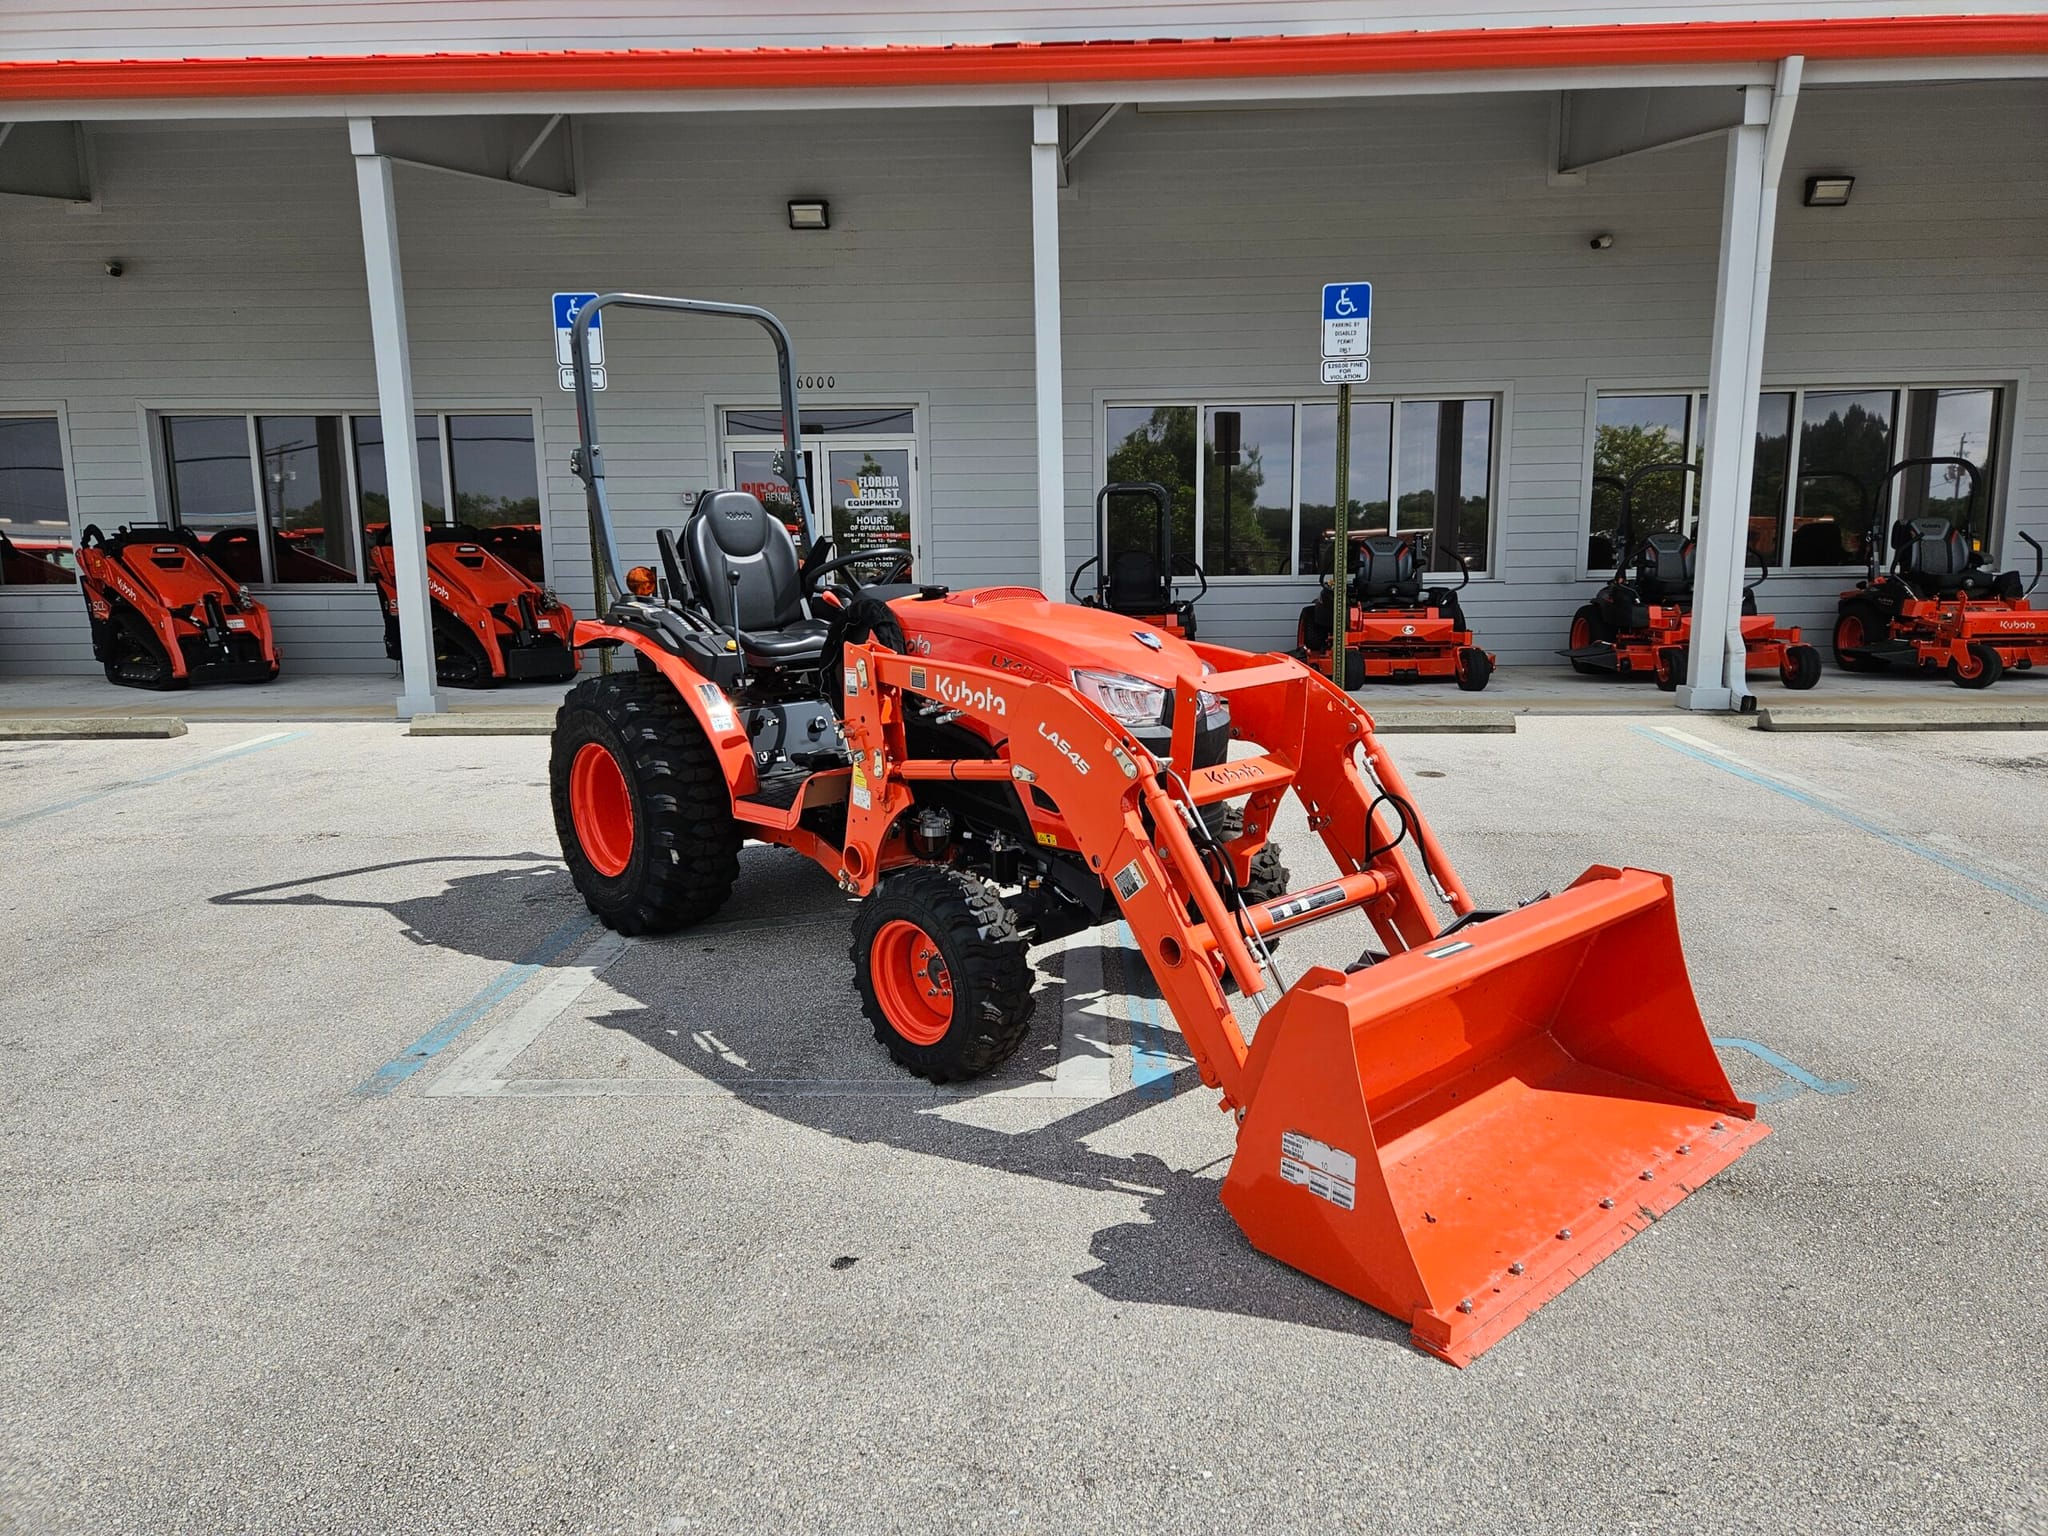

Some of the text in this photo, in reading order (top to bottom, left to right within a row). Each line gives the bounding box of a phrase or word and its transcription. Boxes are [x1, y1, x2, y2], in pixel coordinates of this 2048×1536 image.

[797, 376, 835, 389] 6000
[858, 476, 899, 488] FLORIDA
[860, 488, 900, 499] COAST
[856, 516, 889, 525] HOURS
[117, 577, 137, 601] Kubota
[2000, 621, 2035, 629] Kubota
[907, 634, 932, 655] ota
[936, 674, 1006, 716] Kubota
[1038, 722, 1091, 775] LA545
[1204, 764, 1264, 784] Kubota
